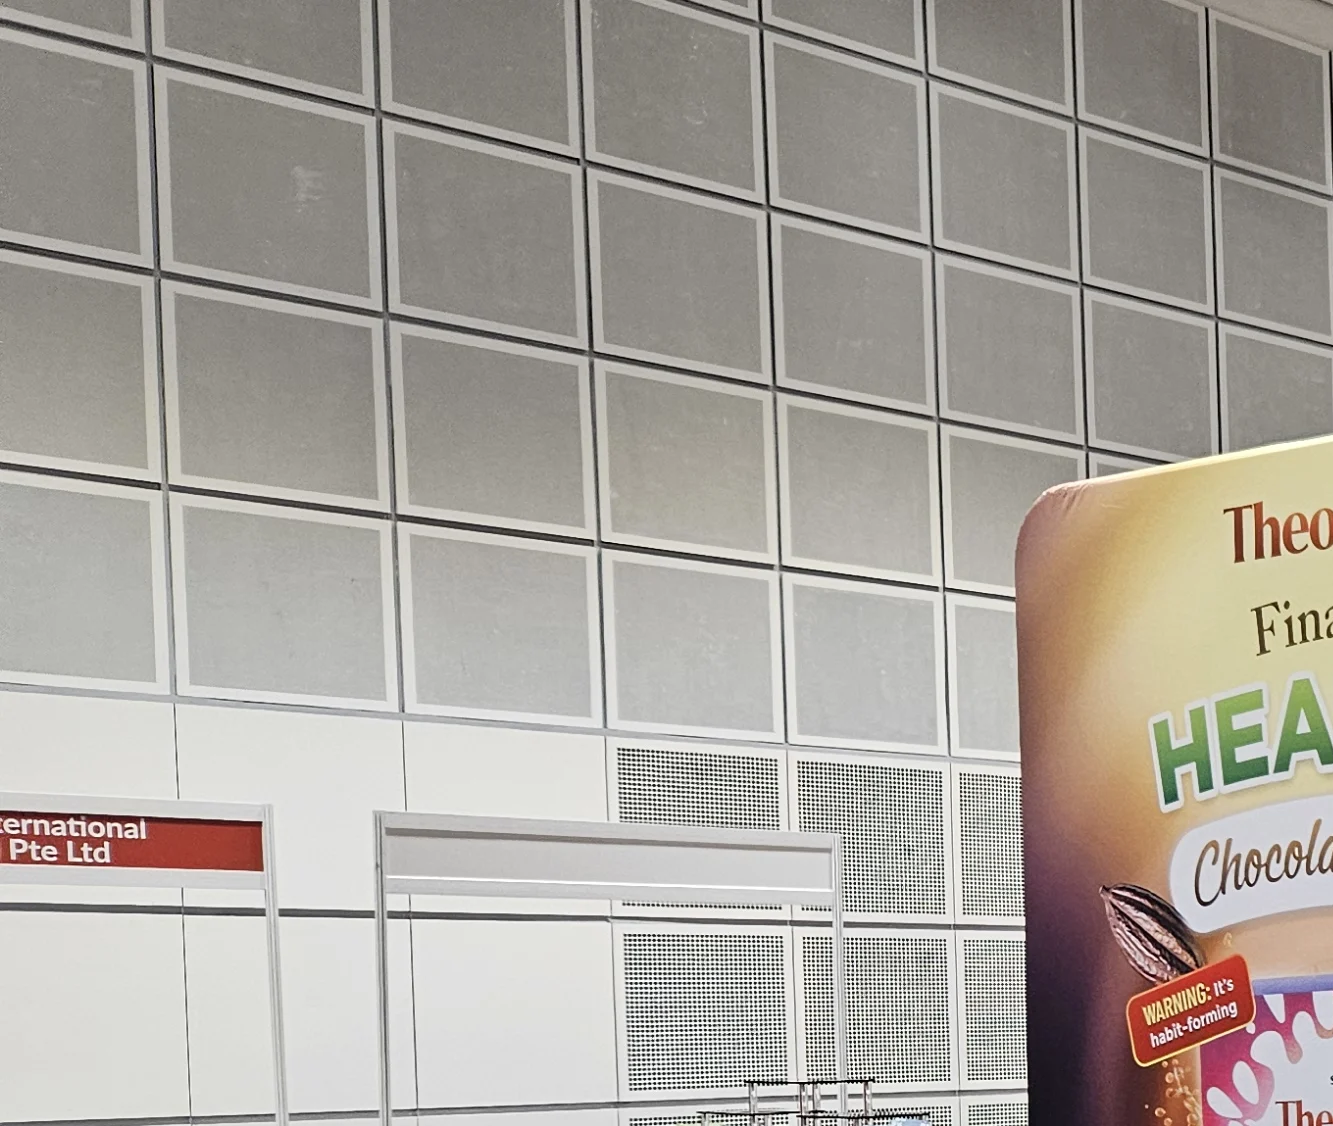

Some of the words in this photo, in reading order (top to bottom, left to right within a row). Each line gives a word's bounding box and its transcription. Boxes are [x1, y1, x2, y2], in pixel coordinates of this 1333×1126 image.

[9, 839, 58, 862] Pte
[67, 840, 111, 863] Ltd
[1142, 983, 1212, 1026] WARNING:
[1213, 979, 1234, 996] It's
[1149, 1002, 1238, 1048] habit-forming
